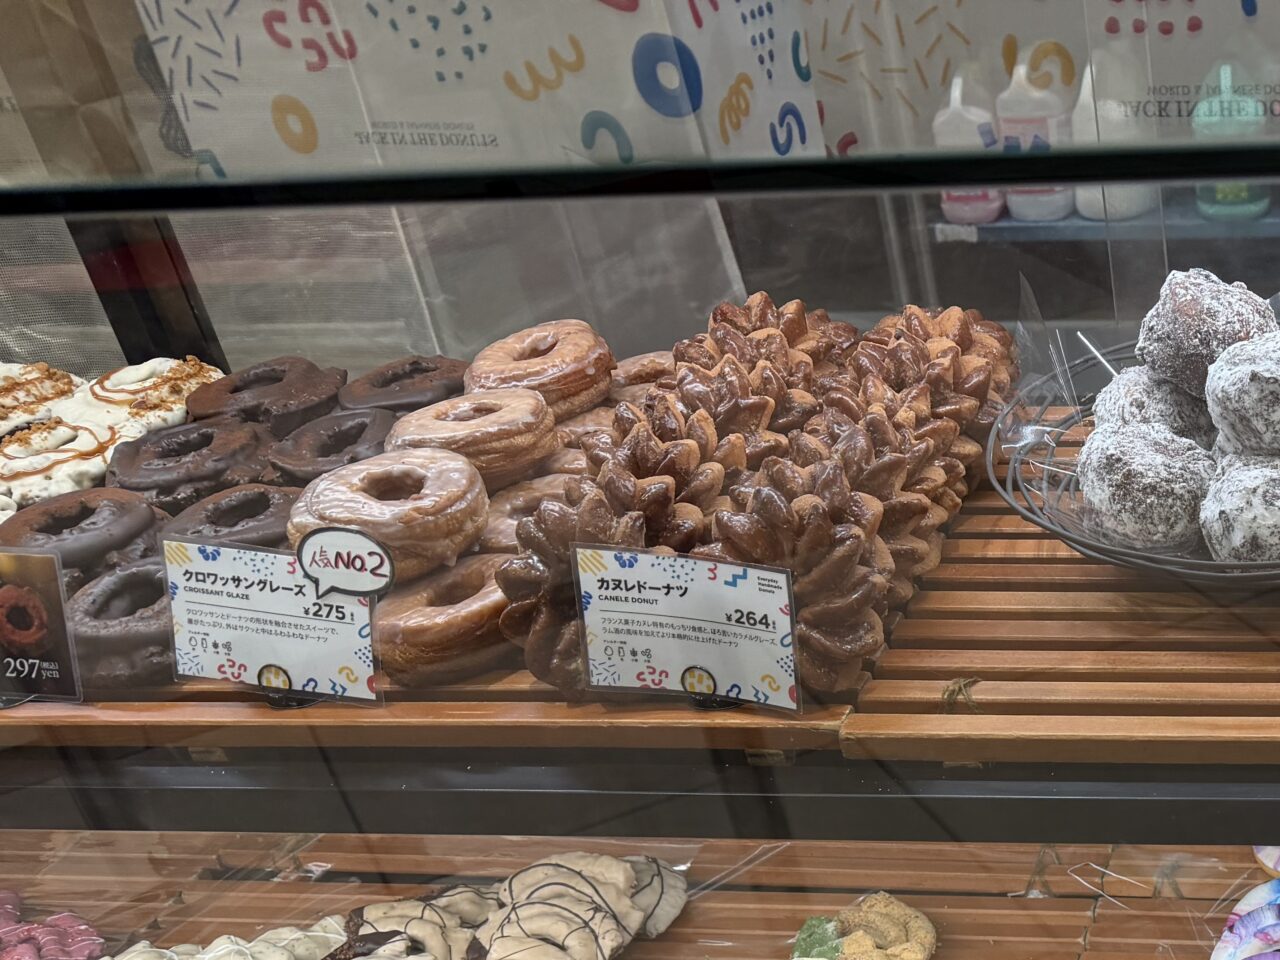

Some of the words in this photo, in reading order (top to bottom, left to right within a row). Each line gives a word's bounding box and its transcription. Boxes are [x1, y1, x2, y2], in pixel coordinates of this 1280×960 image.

[182, 569, 306, 597] クロワッサングレーズ
[184, 586, 225, 598] CROISSANT
[227, 591, 250, 601] GLAZE
[597, 577, 688, 598] カヌレドーナツ
[598, 594, 630, 604] CANELE
[631, 596, 659, 606] DONUT
[3, 657, 40, 679] 297
[41, 668, 60, 679] yen
